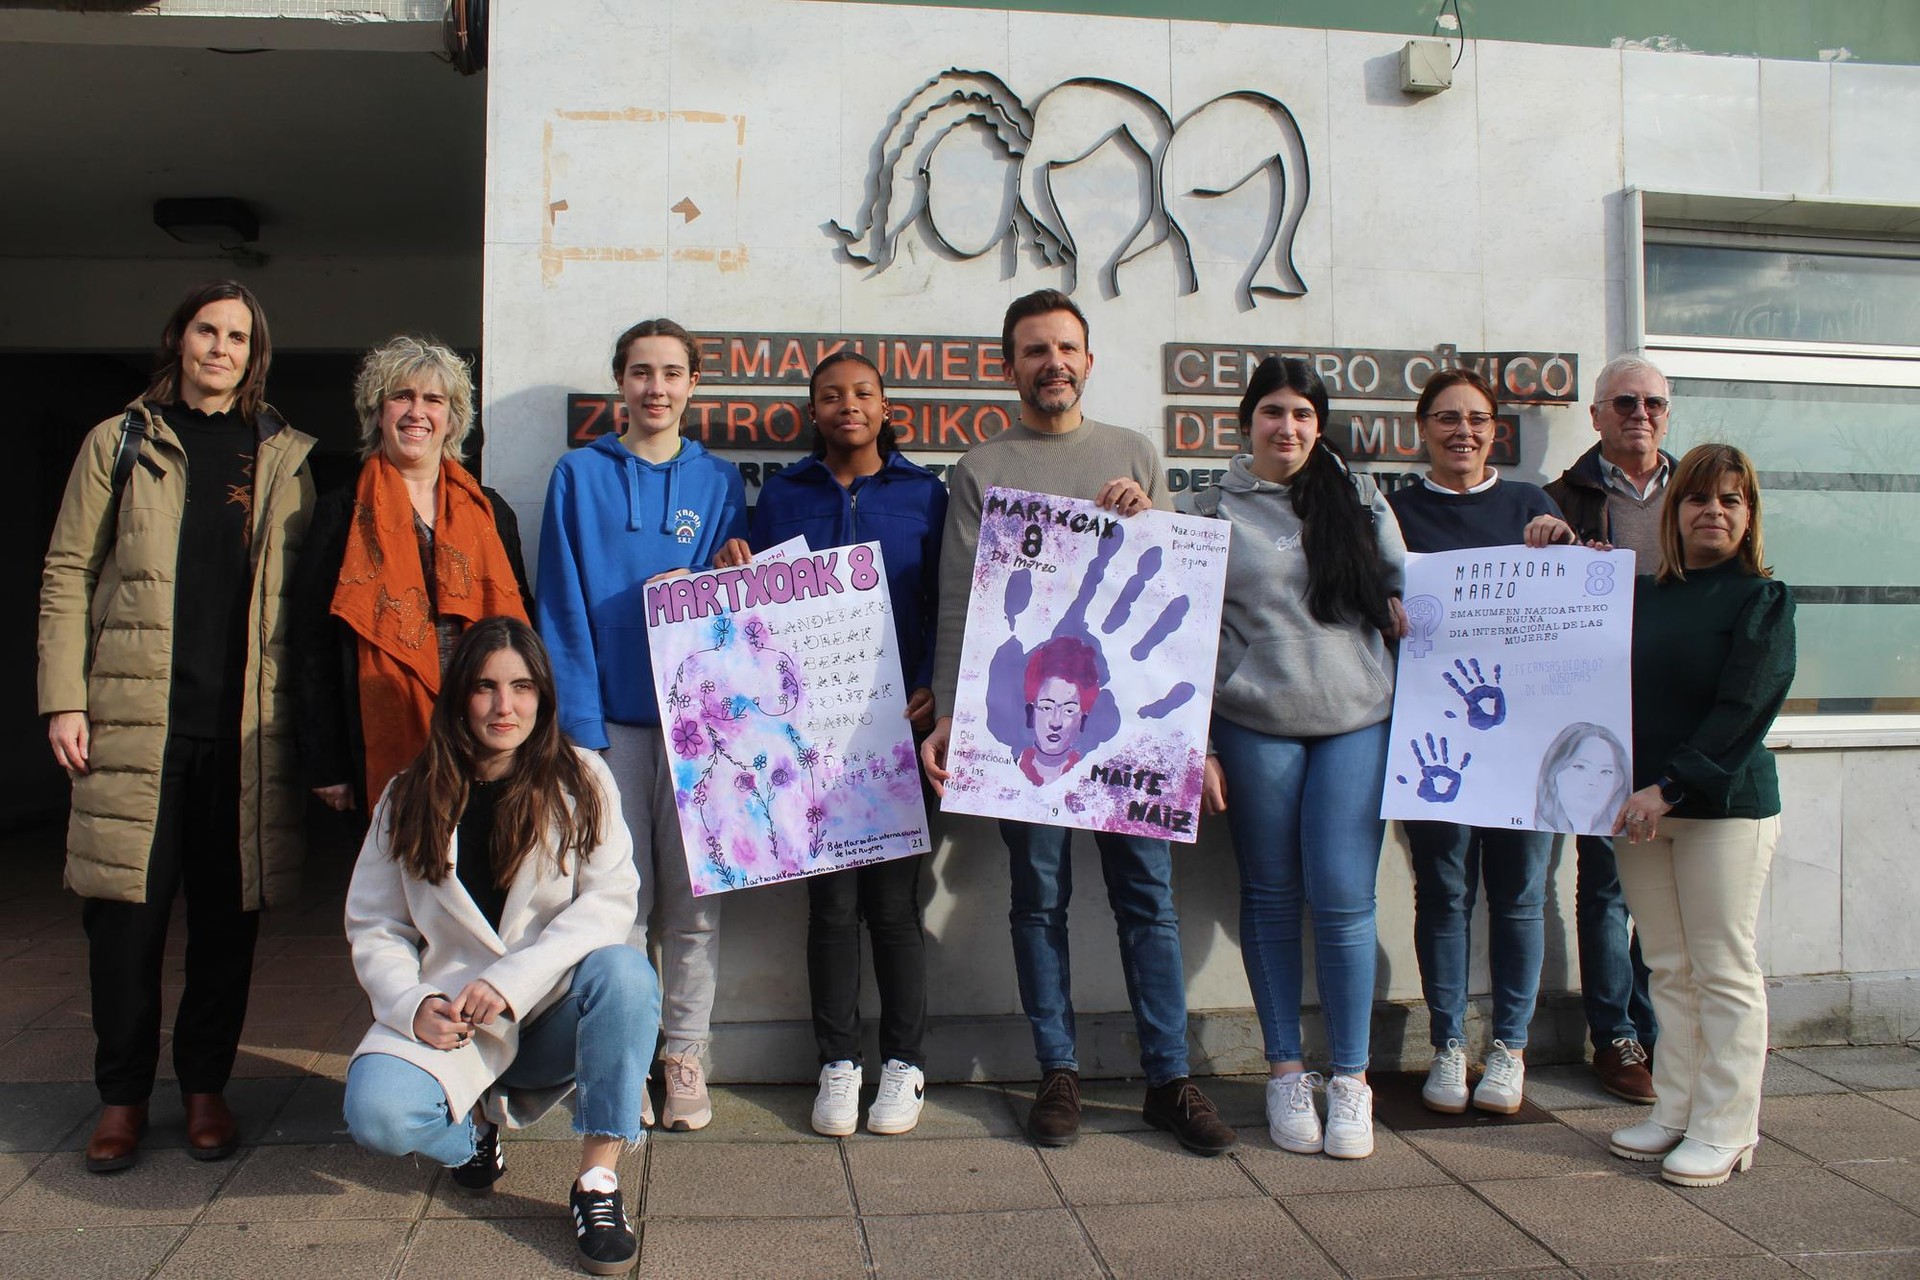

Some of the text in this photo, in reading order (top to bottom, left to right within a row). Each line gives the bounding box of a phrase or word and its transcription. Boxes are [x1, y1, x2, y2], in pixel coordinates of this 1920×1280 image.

[696, 336, 1006, 382] EMAKUMEE
[1173, 349, 1381, 394] CERO
[573, 400, 803, 443] ZTRO
[1174, 410, 1516, 456] DE MUR
[1021, 524, 1043, 558] 8
[647, 545, 879, 628] MARTXOAK 8
[1584, 560, 1615, 597] 8
[1453, 581, 1516, 602] MARZO
[1450, 603, 1609, 619] EMAKUMEEN NAZIOARTEKO
[1505, 614, 1545, 624] EGUNA
[1449, 619, 1604, 638] DIA INTERNACIONAL DE LAS
[1504, 632, 1559, 645] MUJERES
[971, 767, 984, 777] las
[1051, 807, 1059, 818] 9
[1510, 817, 1523, 826] 16
[827, 841, 833, 852] 8
[833, 841, 843, 850] de
[911, 838, 924, 849] 21
[834, 850, 843, 858] de
[845, 848, 857, 856] las
